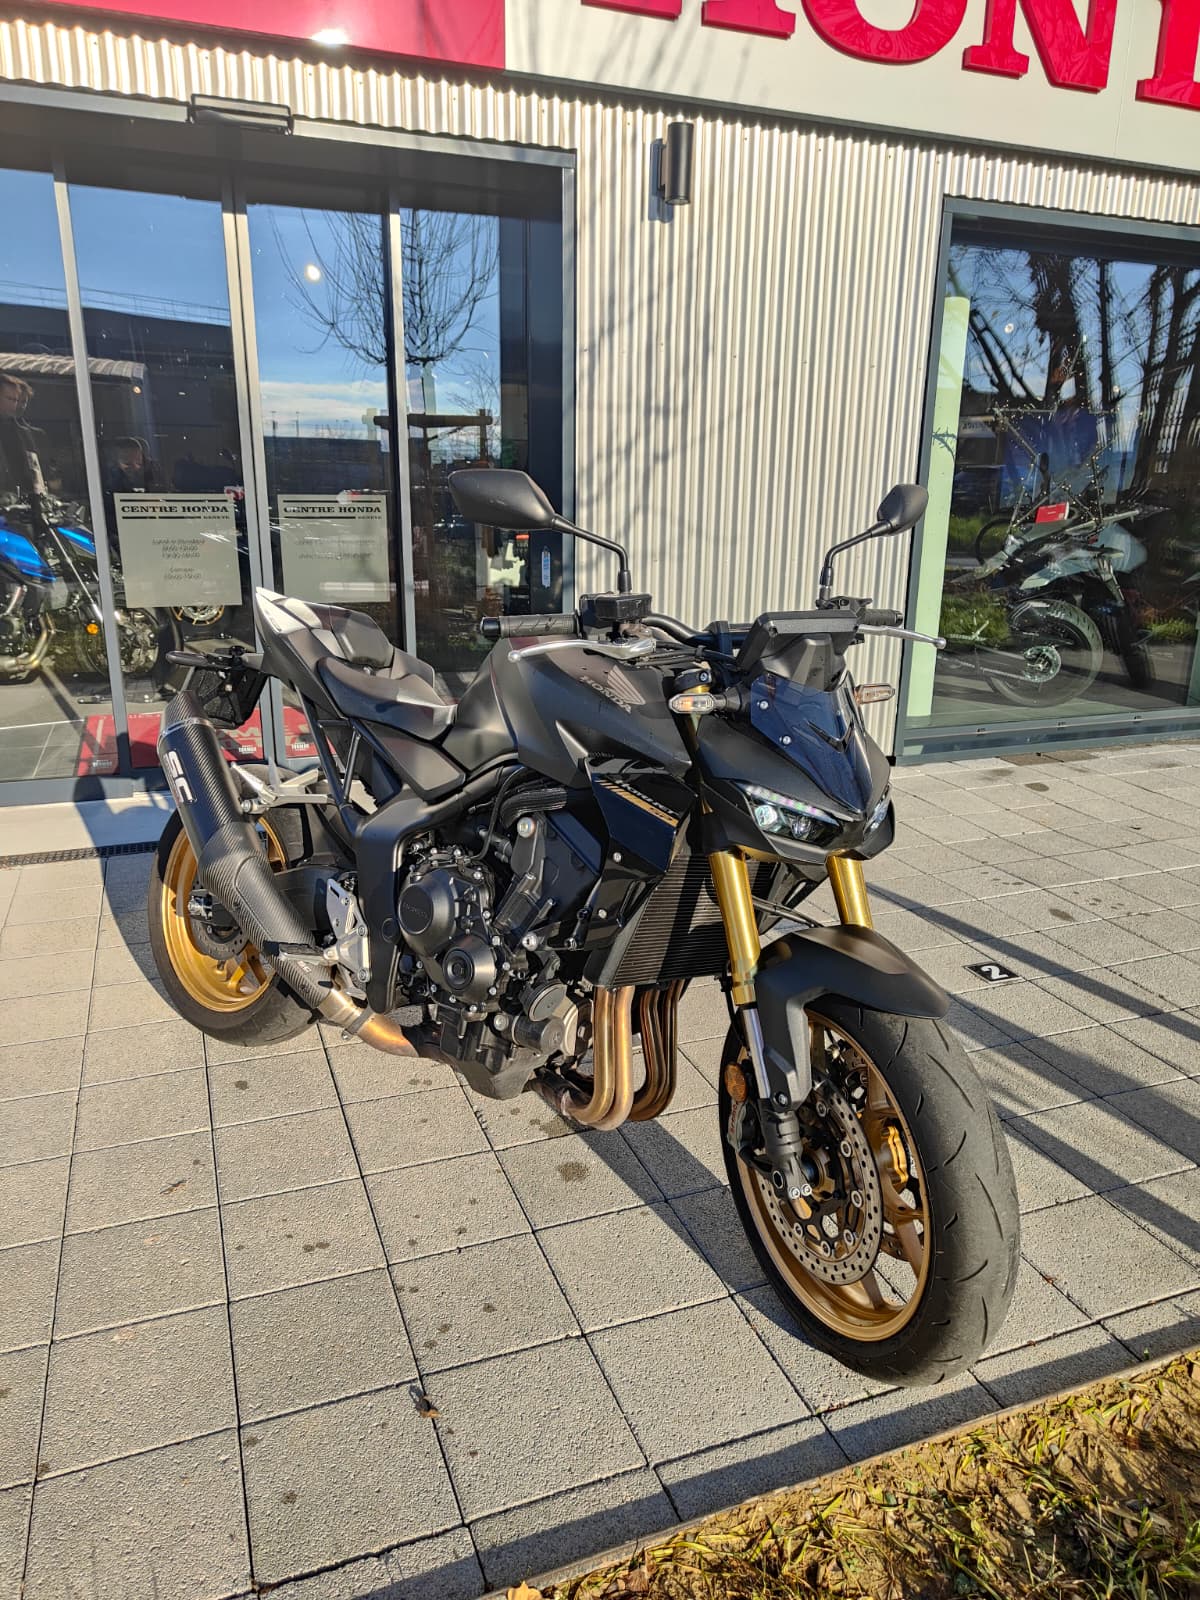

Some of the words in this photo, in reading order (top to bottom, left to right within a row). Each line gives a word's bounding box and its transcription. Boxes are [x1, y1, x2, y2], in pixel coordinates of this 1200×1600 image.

[121, 505, 178, 513] CENTRE
[181, 505, 229, 513] HONDA
[579, 675, 632, 714] HONDA
[163, 750, 193, 803] SC
[981, 965, 1009, 980] 2
